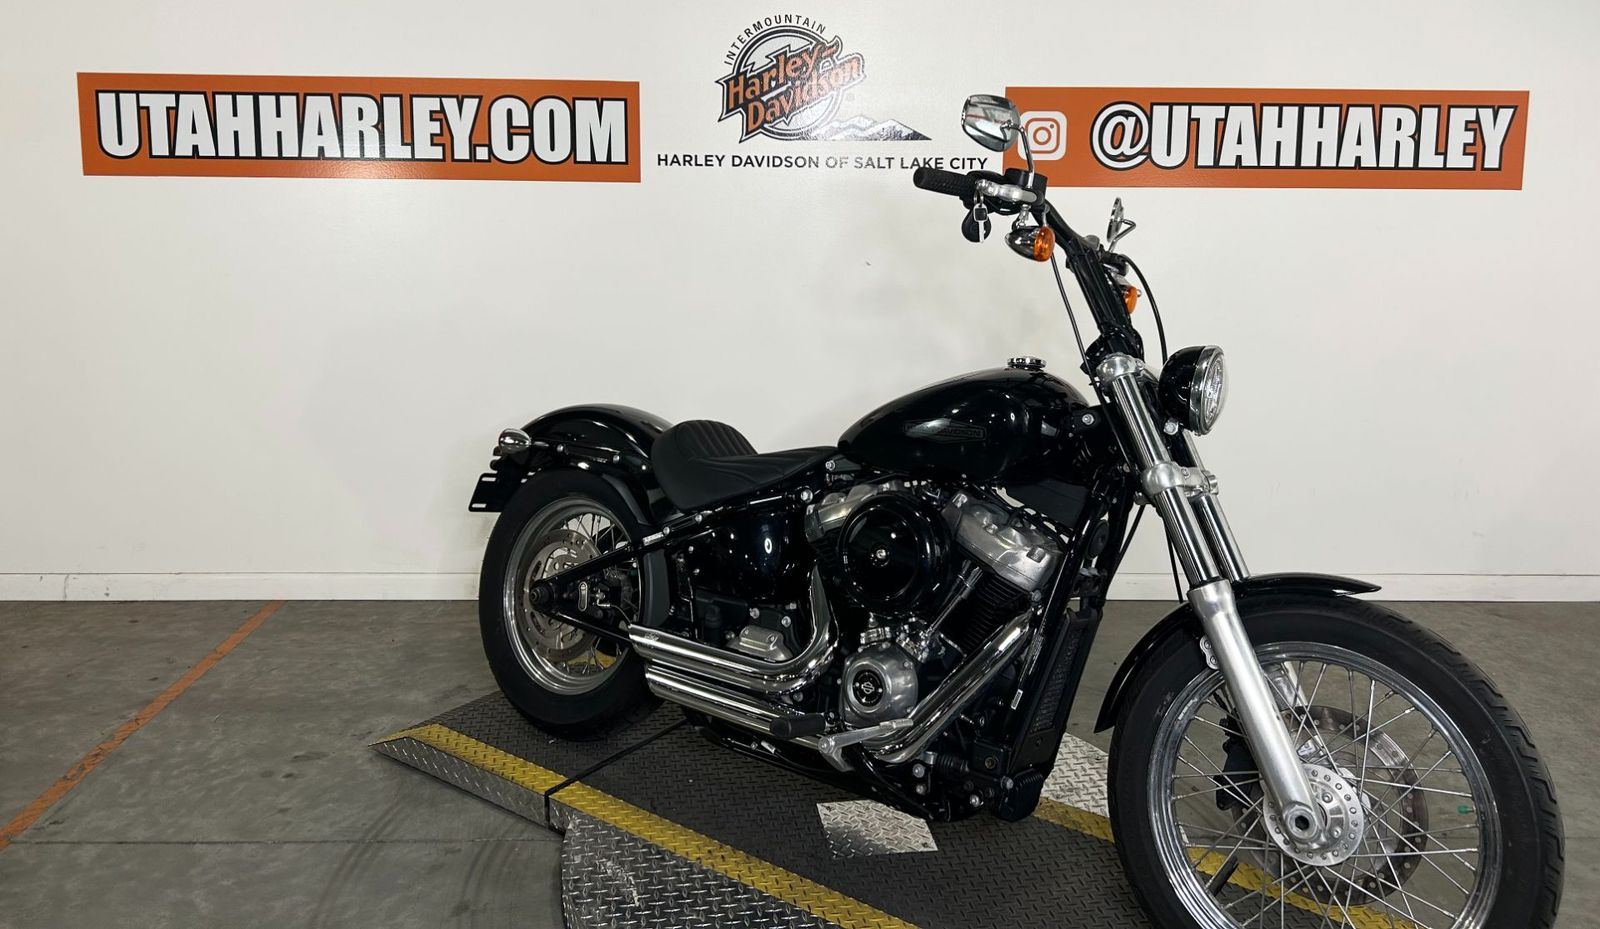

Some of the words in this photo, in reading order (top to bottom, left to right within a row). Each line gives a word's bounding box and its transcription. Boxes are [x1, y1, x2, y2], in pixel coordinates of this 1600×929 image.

[723, 14, 827, 66] INTERMOUNTAIN
[96, 89, 628, 165] UTAHHARLEY.COM
[747, 57, 859, 132] Davidson
[656, 153, 726, 168] HARLEY
[731, 154, 820, 169] DAVIDSON
[825, 155, 849, 169] OF
[853, 156, 895, 169] SALT
[900, 156, 944, 170] LAKE
[949, 157, 988, 170] CITY
[1089, 101, 1518, 171] @UTAHHARLEY
